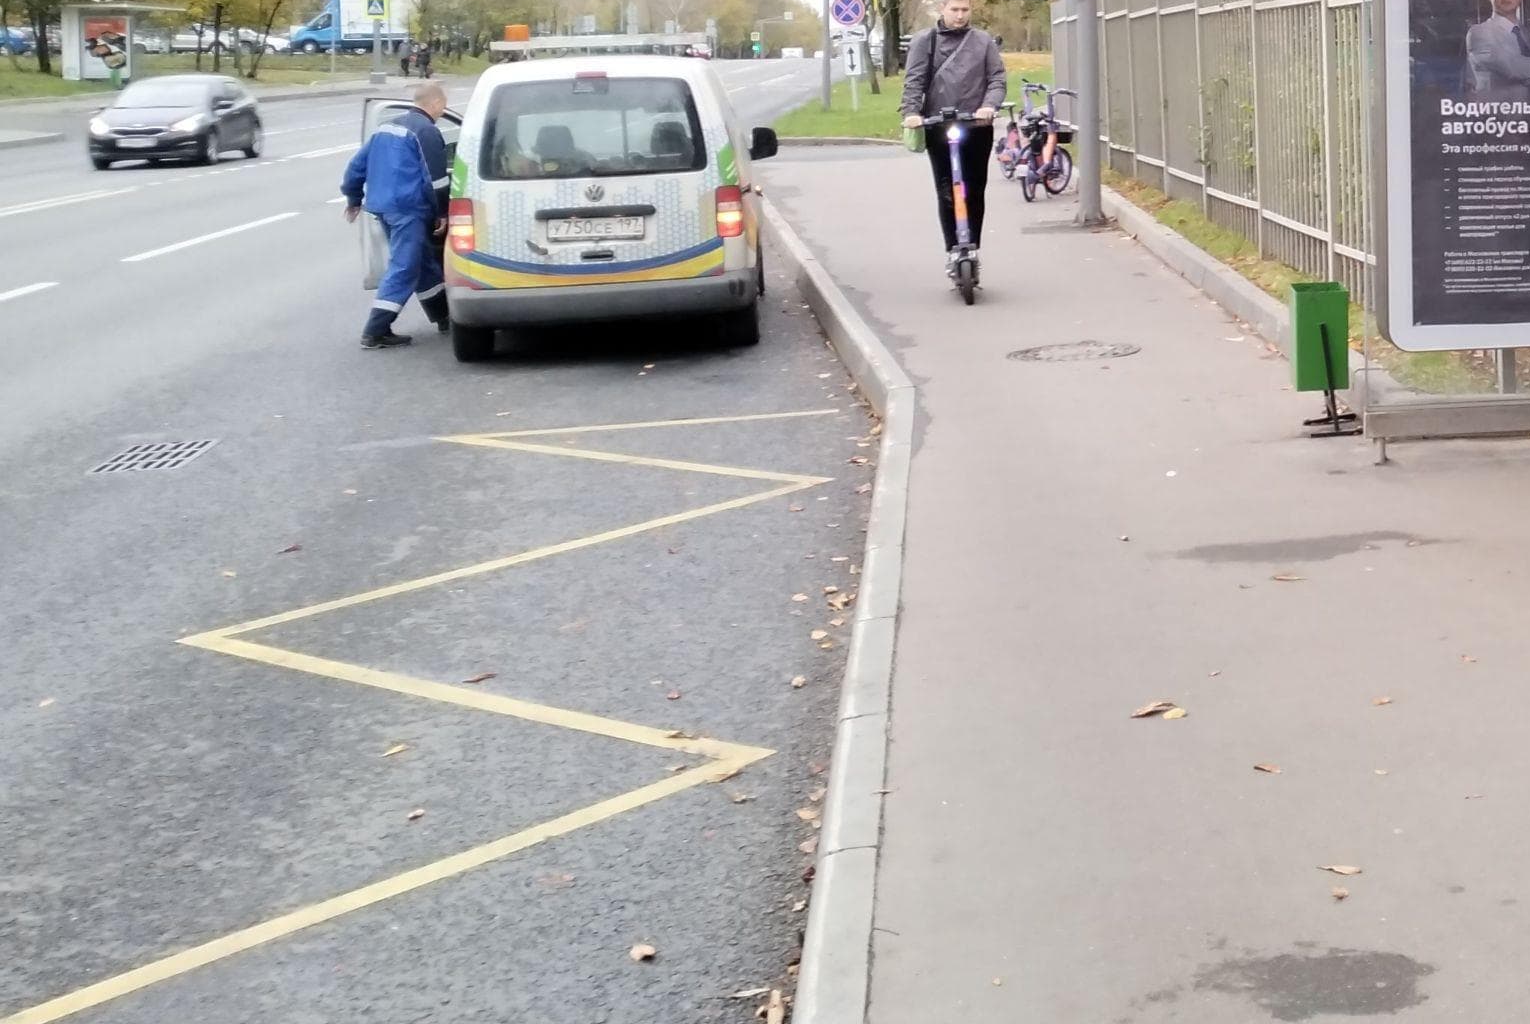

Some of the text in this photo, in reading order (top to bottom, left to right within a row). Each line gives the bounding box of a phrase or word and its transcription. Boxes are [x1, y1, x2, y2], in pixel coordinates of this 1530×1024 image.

[1441, 117, 1529, 138] автобуса
[1442, 143, 1461, 154] Эта
[1462, 143, 1518, 155] профессия
